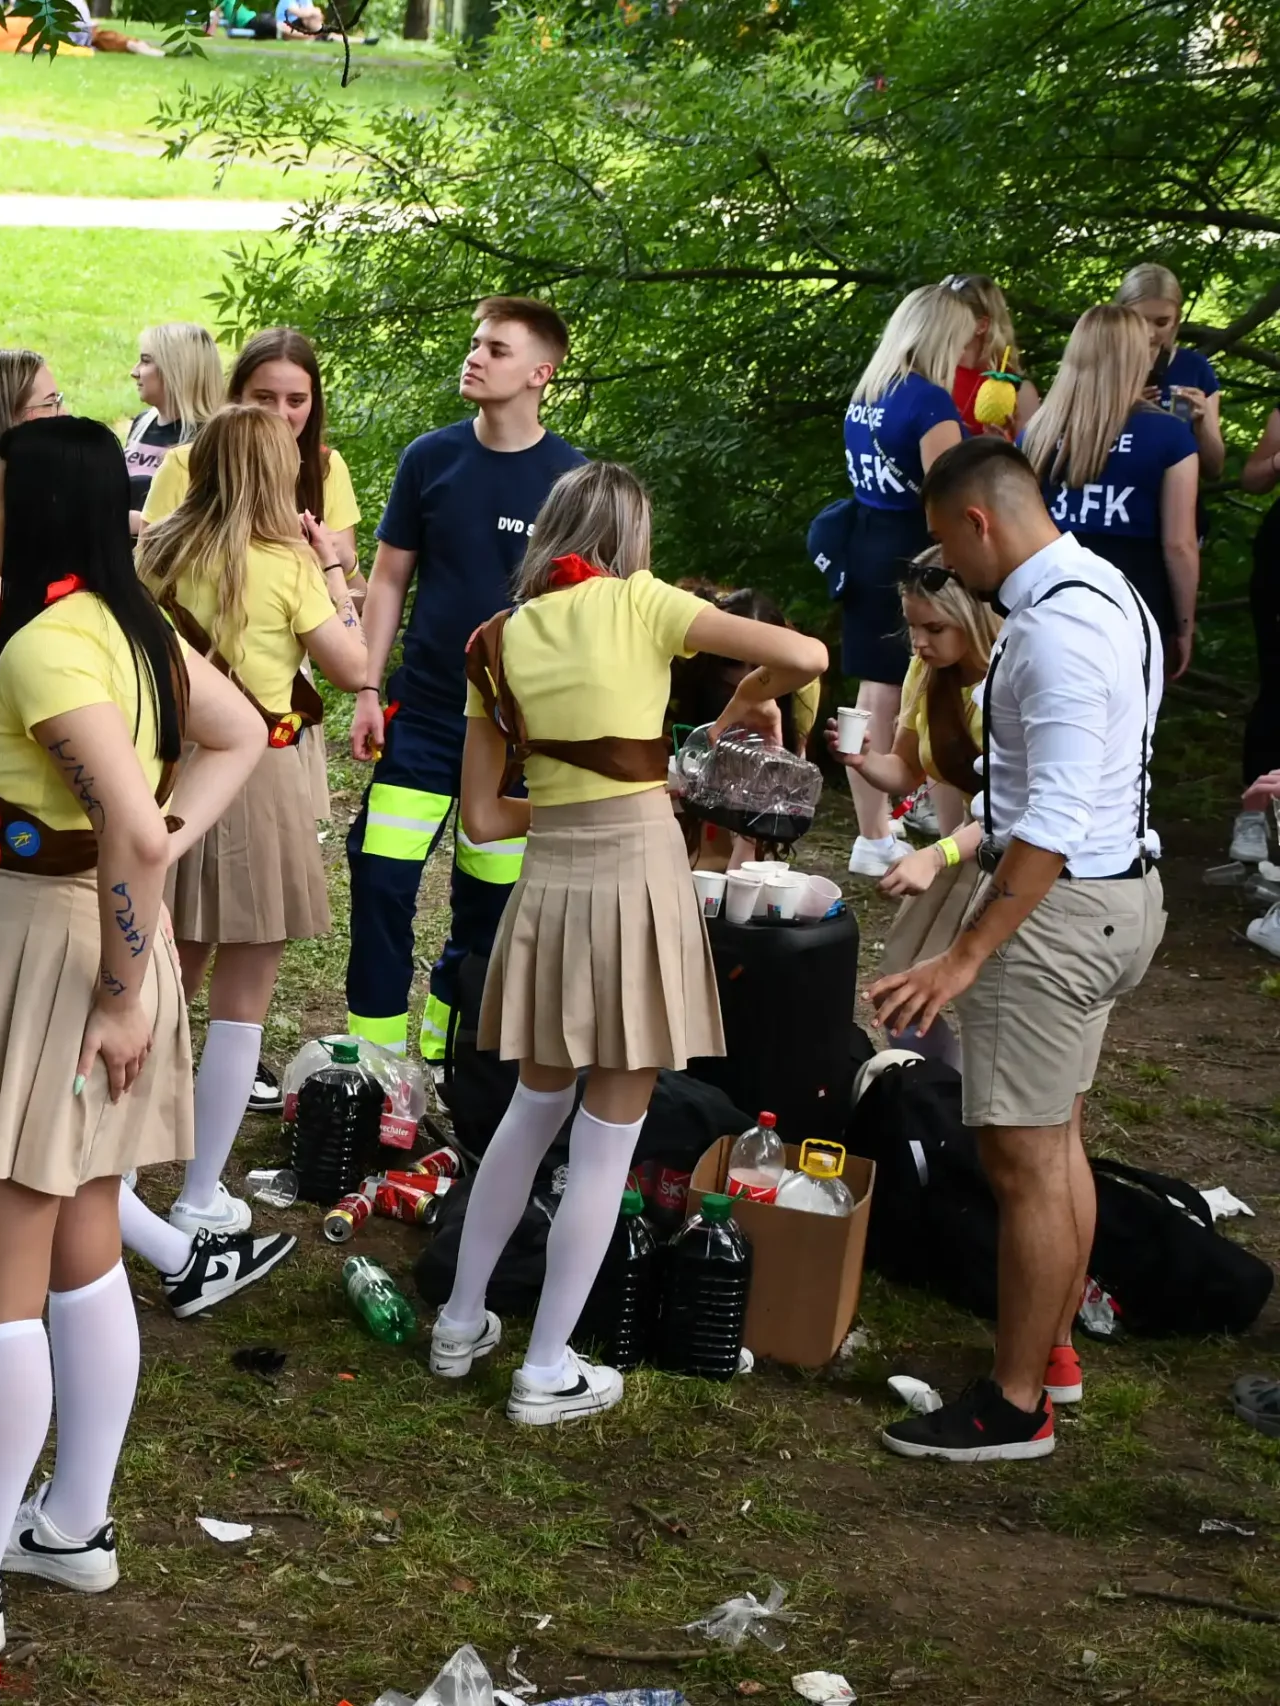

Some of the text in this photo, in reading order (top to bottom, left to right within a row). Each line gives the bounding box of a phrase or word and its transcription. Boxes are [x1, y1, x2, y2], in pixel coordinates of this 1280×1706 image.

[498, 516, 536, 537] DVD S
[1051, 481, 1136, 527] 3.FK
[111, 882, 147, 958] KARLA
